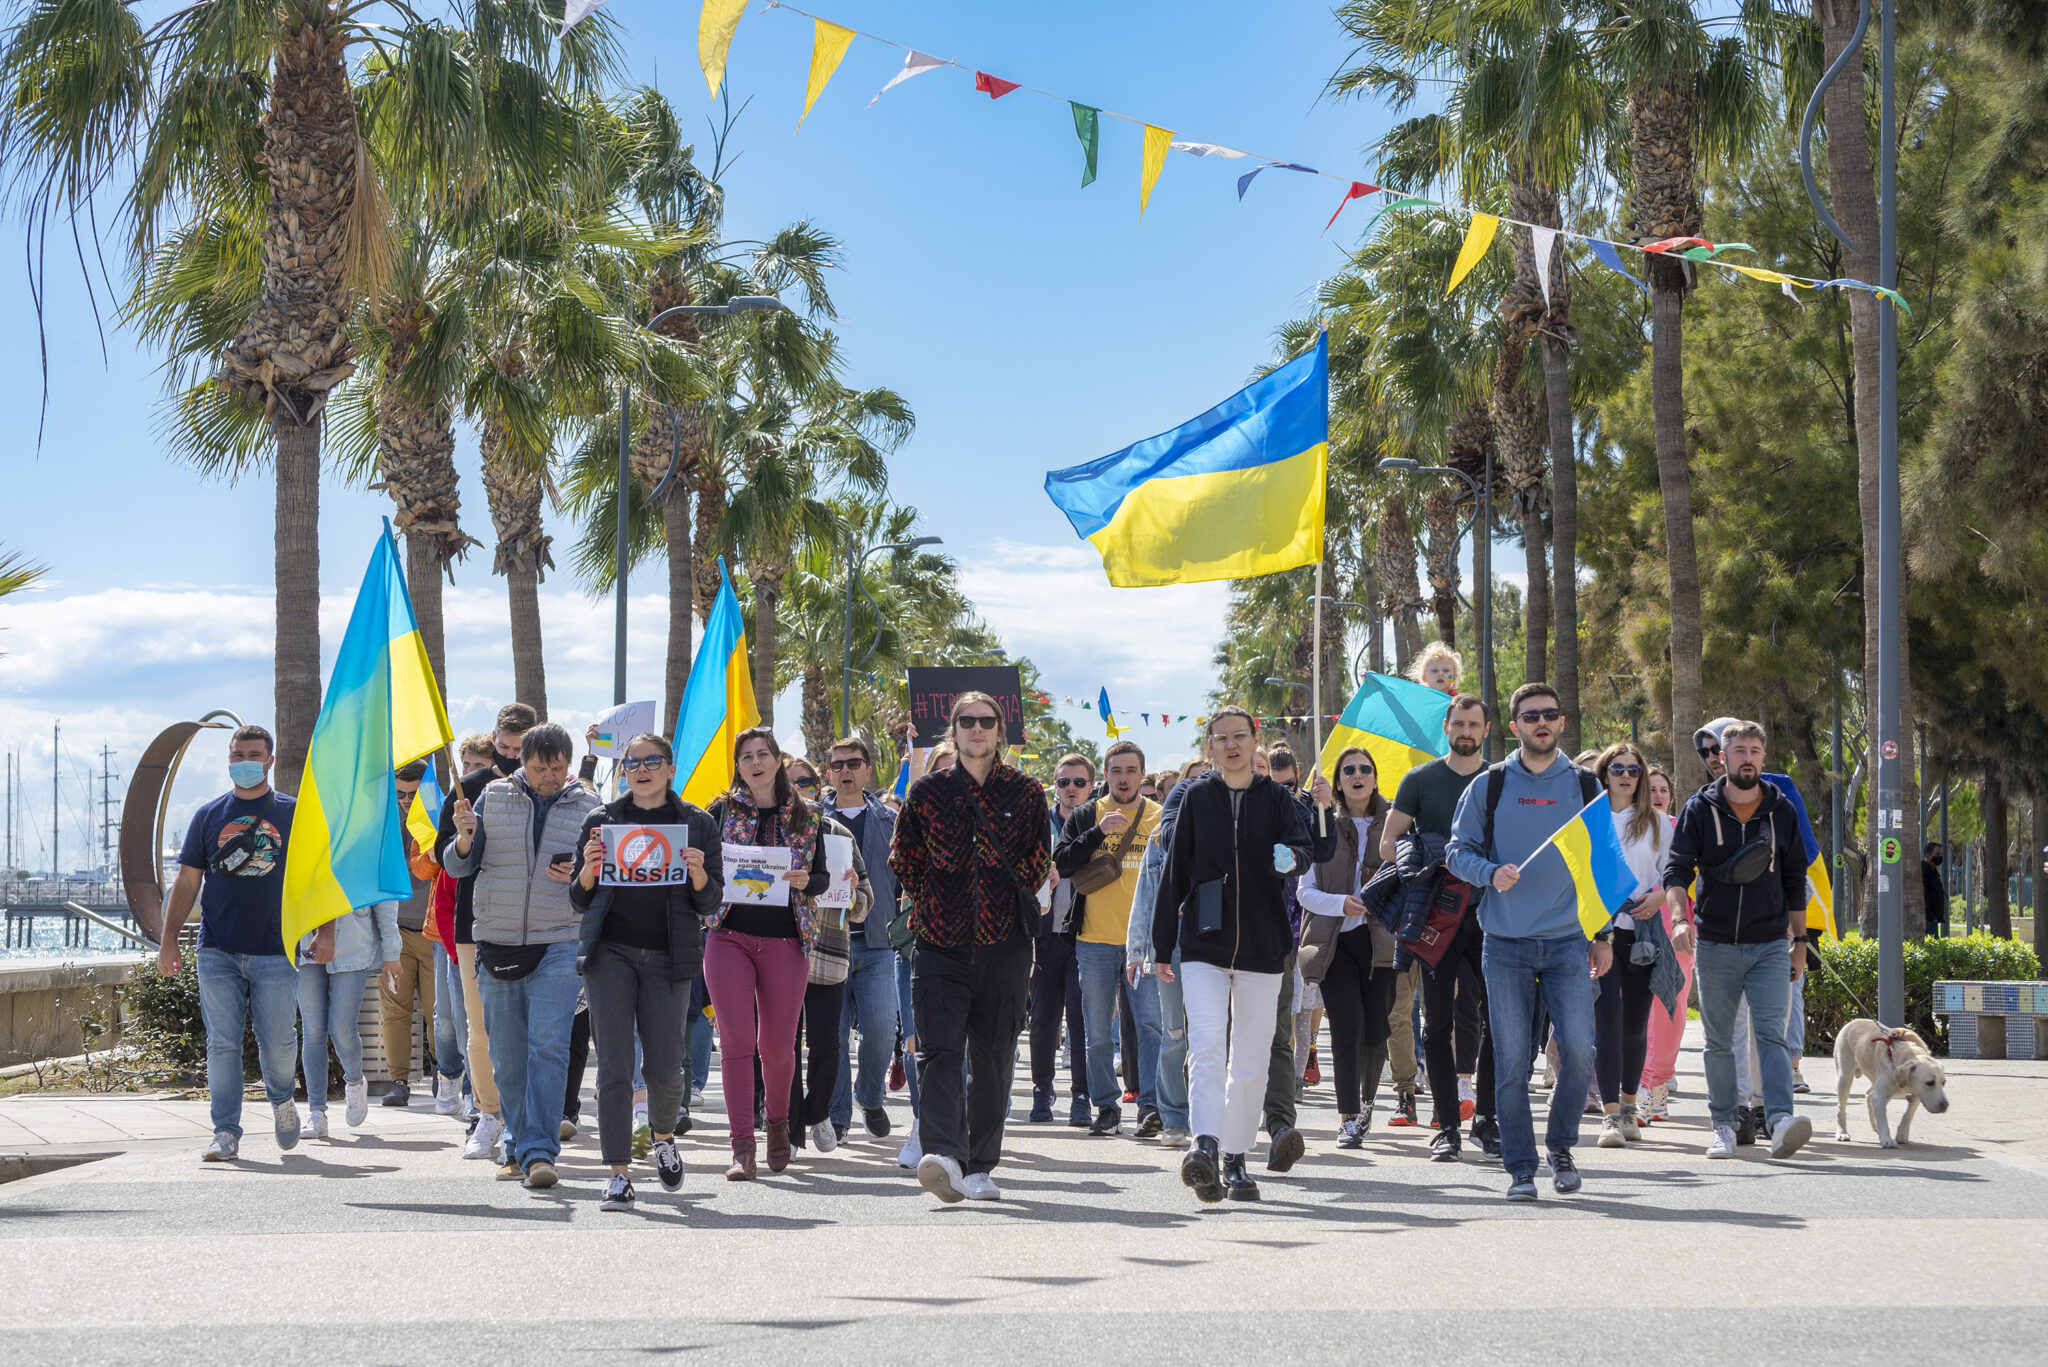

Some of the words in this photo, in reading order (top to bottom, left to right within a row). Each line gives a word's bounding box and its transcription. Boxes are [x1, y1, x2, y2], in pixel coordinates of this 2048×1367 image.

[723, 855, 738, 863] Stop
[761, 863, 788, 871] Ukraine!
[601, 862, 684, 883] Russia
